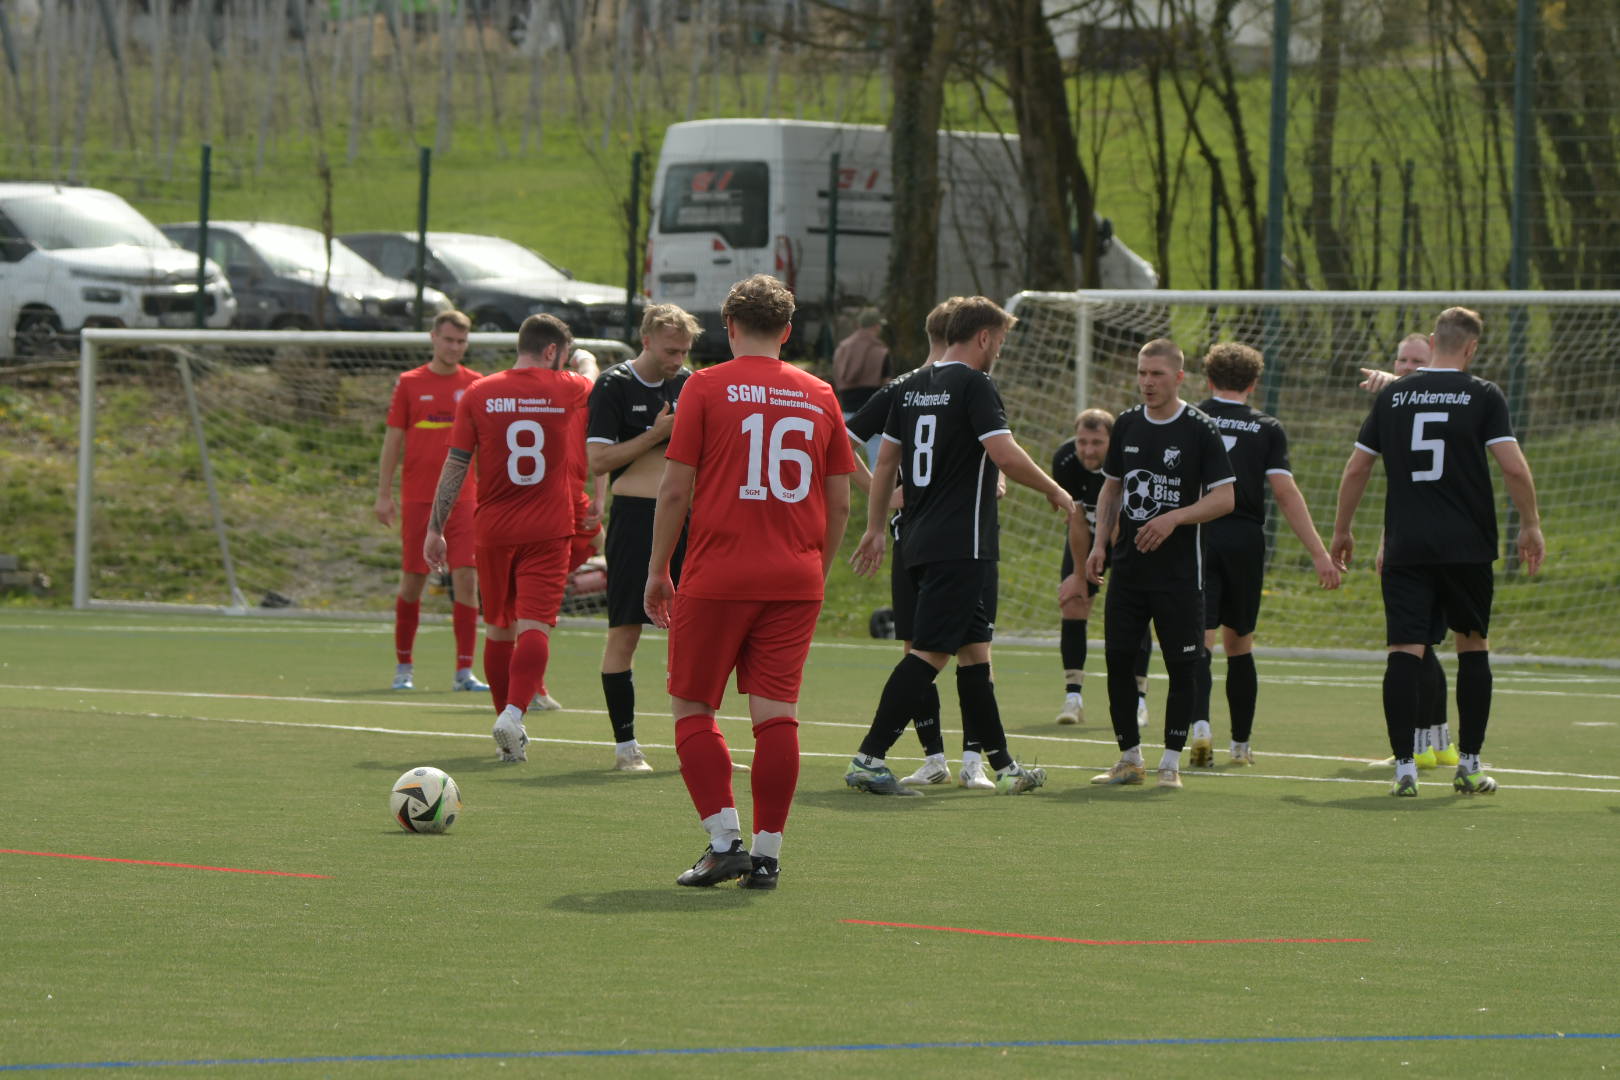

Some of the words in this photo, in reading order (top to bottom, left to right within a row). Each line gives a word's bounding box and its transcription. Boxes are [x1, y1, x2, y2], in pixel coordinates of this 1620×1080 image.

[726, 384, 767, 404] SGM
[903, 391, 914, 407] SV
[912, 389, 950, 407] Ankenreute
[1392, 391, 1409, 408] SV
[1408, 390, 1471, 405] Ankenreute
[486, 398, 516, 413] SGM
[506, 419, 546, 485] 8
[912, 414, 937, 487] 8
[1411, 412, 1449, 482] 5
[739, 413, 814, 503] 16
[1154, 484, 1180, 502] Biss
